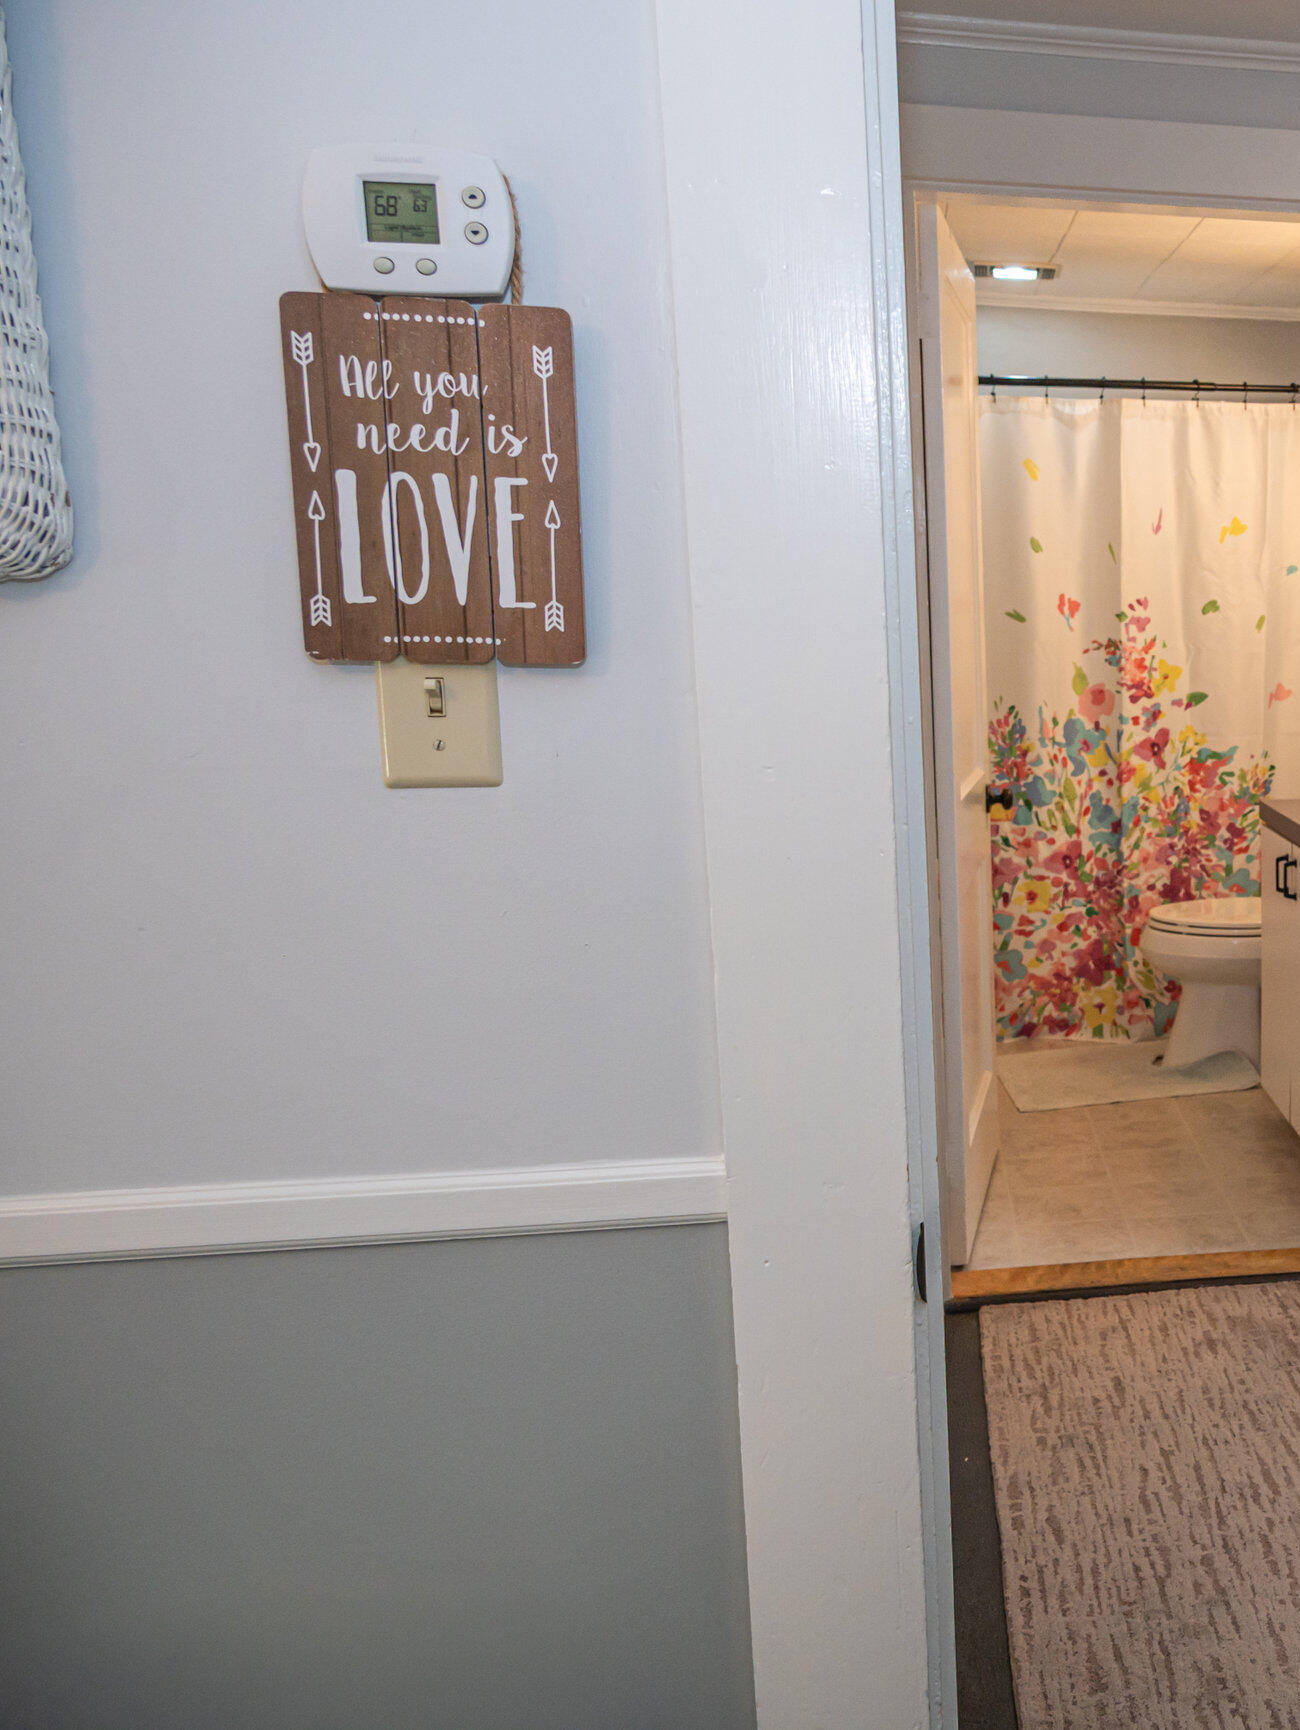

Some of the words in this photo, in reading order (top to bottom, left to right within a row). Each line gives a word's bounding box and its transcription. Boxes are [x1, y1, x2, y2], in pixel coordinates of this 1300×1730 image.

[339, 354, 399, 400] All
[413, 370, 488, 415] you
[357, 408, 470, 456] need
[487, 413, 528, 458] is
[334, 469, 536, 609] LOVE
